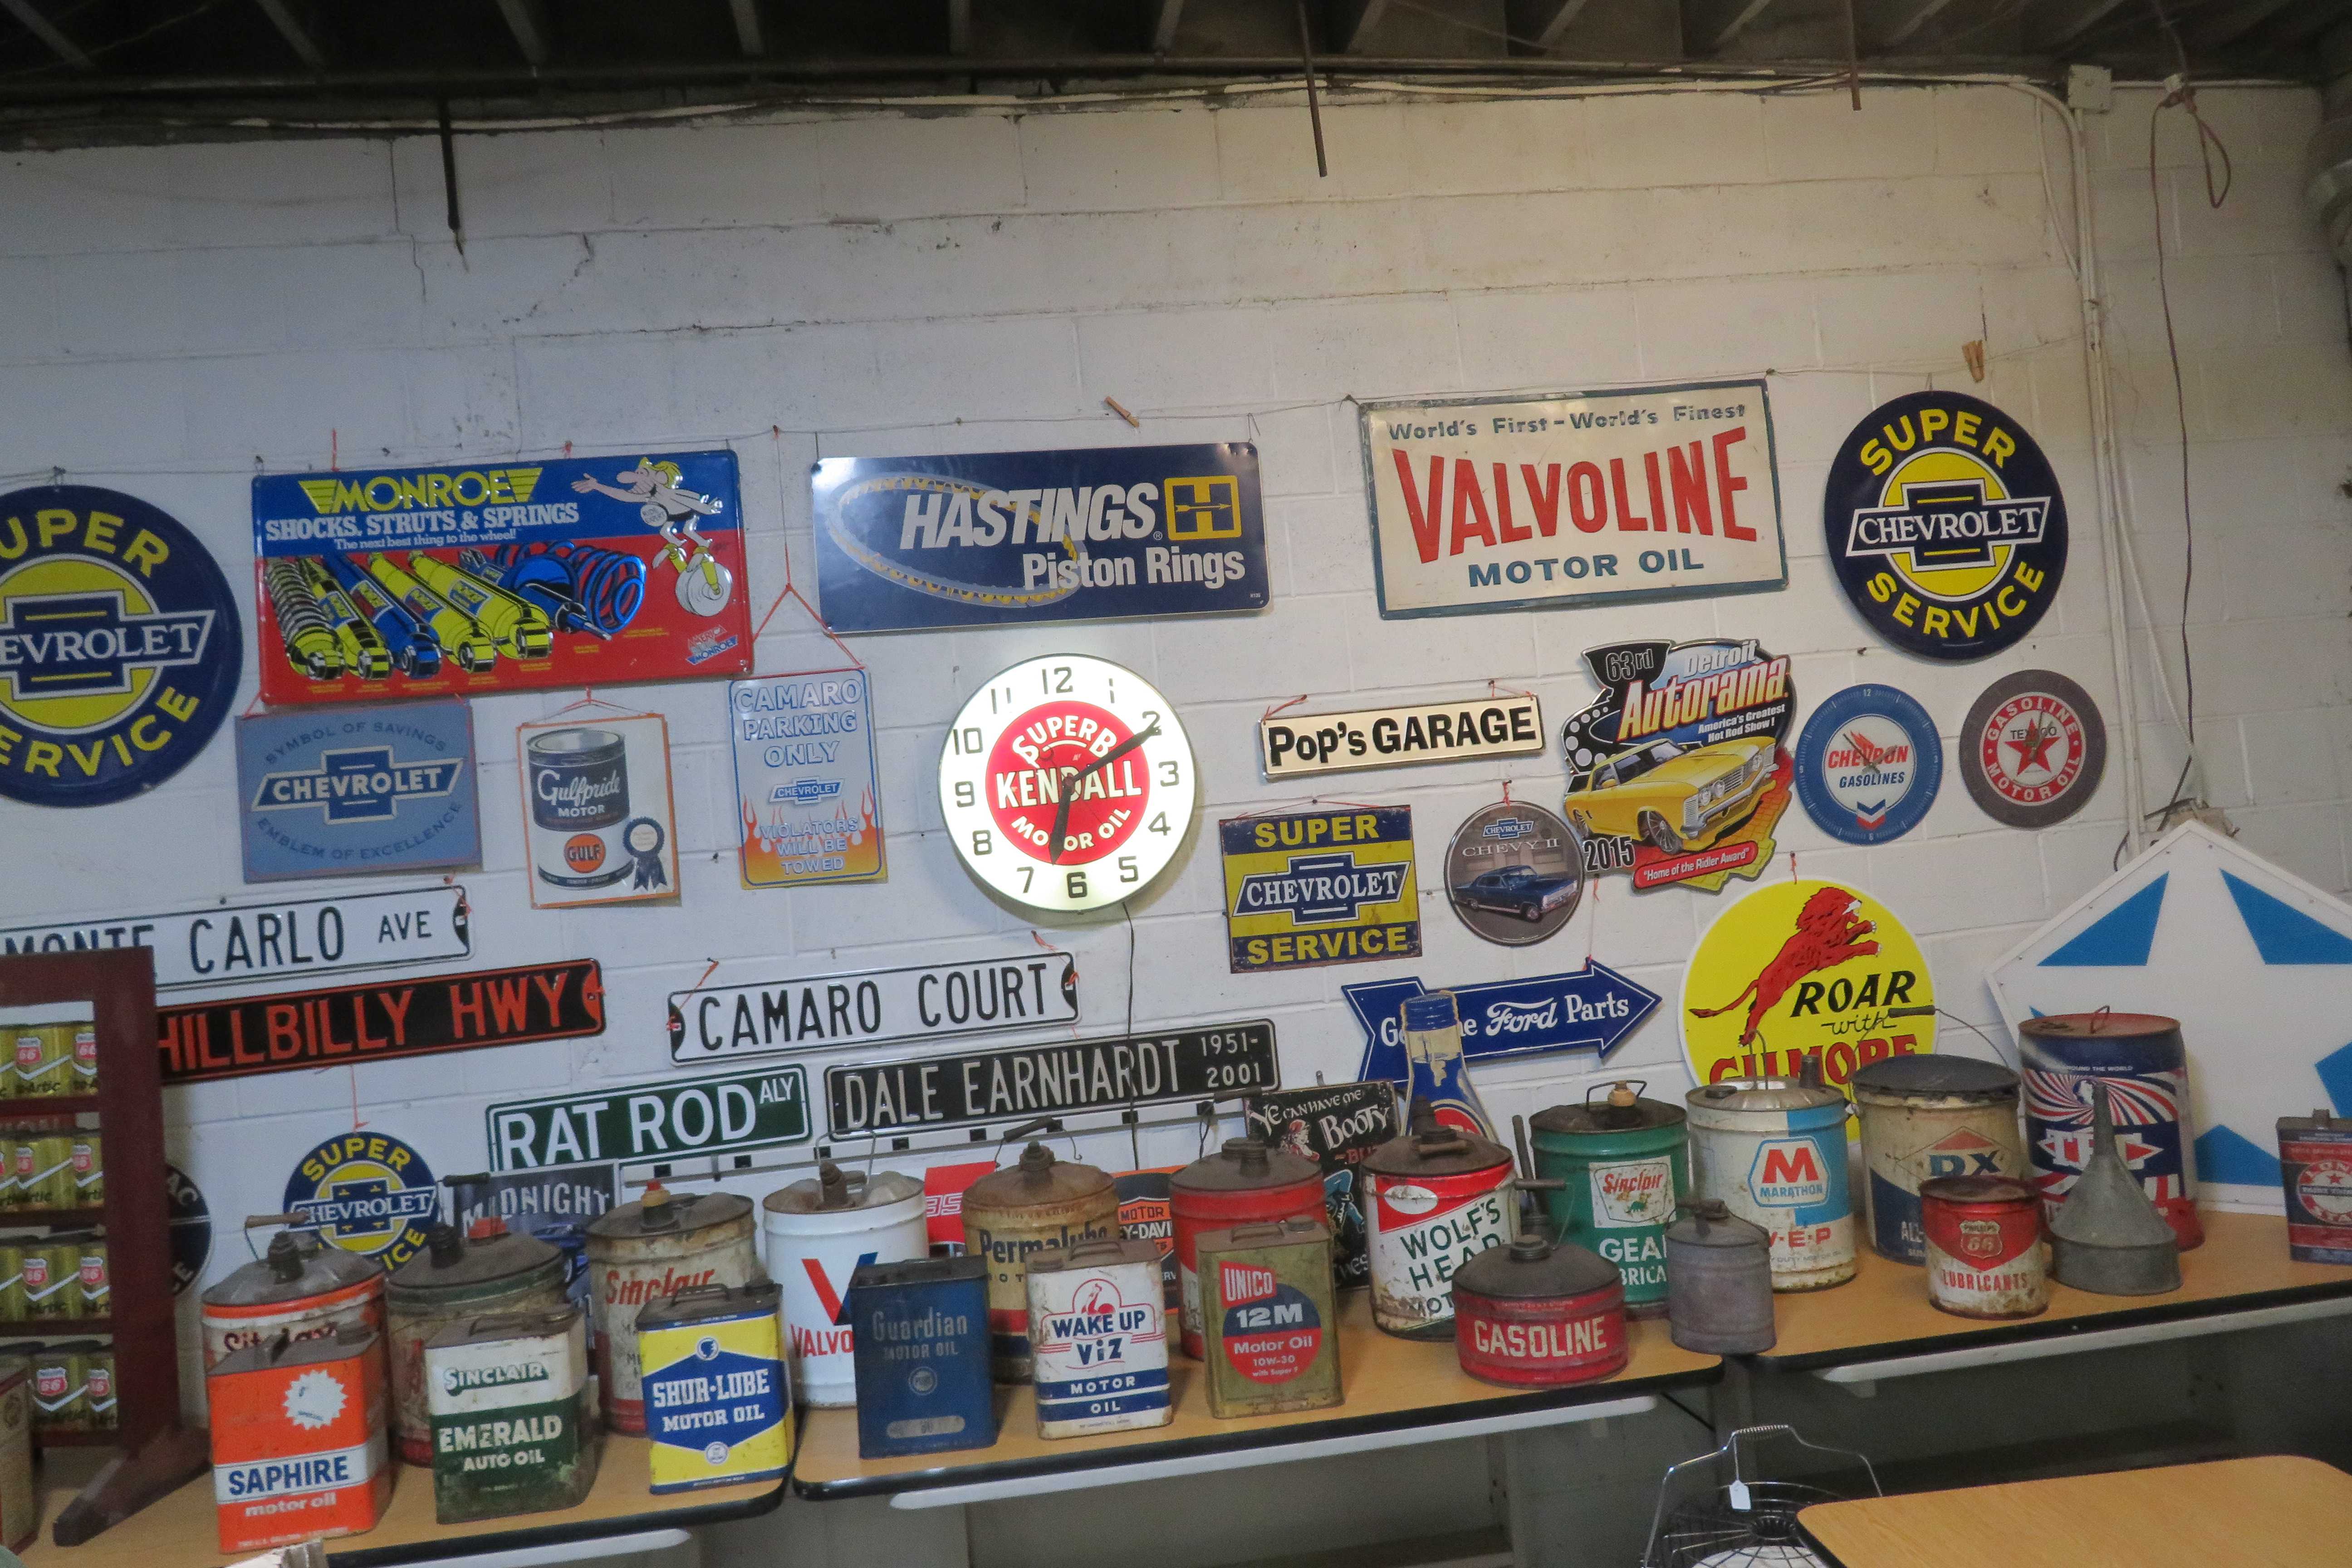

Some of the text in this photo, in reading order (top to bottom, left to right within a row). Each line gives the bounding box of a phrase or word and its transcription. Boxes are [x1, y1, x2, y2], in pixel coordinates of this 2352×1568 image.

[1390, 404, 1746, 440] World's First World's Finest
[1860, 409, 2017, 475] SUPER
[332, 470, 517, 513] MONROE
[1392, 426, 1757, 564] VALVOLINE
[461, 509, 478, 531] &
[483, 503, 579, 529] SPRINGS
[900, 483, 1158, 549] HASTINGS
[1858, 508, 2041, 544] CHEVROLET
[0, 509, 170, 578] UPER
[334, 538, 357, 550] The
[360, 537, 385, 549] next
[387, 536, 411, 547] best
[414, 534, 444, 547] thing
[446, 533, 457, 543] to
[460, 532, 477, 542] the
[1023, 546, 1245, 590] Piston Rings
[1468, 549, 1704, 587] MOTOR OIL
[1867, 561, 2045, 638] SERVICE
[0, 622, 199, 665] EVROLET
[695, 637, 736, 662] MONROE
[1606, 649, 1654, 681] 63rd
[1683, 640, 1757, 679] Detroit
[1042, 666, 1073, 694] 12
[734, 679, 862, 713] CAMARO
[991, 687, 1011, 714] 11
[1616, 657, 1788, 742] Autorama
[0, 686, 200, 777] ERVICE
[744, 710, 858, 740] PARKING
[1142, 710, 1162, 735] 2
[1698, 704, 1785, 734] America's Greatest
[1987, 697, 2078, 740] GASOLINE
[265, 722, 446, 764] SYMBOL OF SAVINGS
[953, 727, 983, 755] 10
[1012, 715, 1117, 768] SUPERB
[1268, 706, 1536, 766] Pop's GARAGE
[1708, 731, 1724, 743] Hot
[1725, 725, 1743, 738] Rod
[764, 740, 840, 767] ONLY
[1828, 746, 1909, 769] CHEVRON
[272, 768, 442, 801] CHEVROLET
[537, 769, 620, 806] Gulfpride
[996, 760, 1142, 809] KENDALL
[1159, 760, 1179, 787] 3
[1839, 772, 1906, 788] GASOLINES
[1988, 757, 2080, 801] MOTOR OIL
[777, 782, 838, 797] CHEVROLET
[955, 781, 975, 808] 9
[558, 805, 605, 817] MOTOR
[1148, 812, 1171, 836] 4
[258, 803, 462, 860] EMBLEM OF EXCELLENCE
[761, 817, 860, 839] VIOLATORS
[973, 830, 992, 855] 8
[1011, 808, 1131, 851] MOOR OIL
[1255, 814, 1379, 848] SUPER
[1485, 823, 1532, 835] CHEVROLET
[568, 844, 601, 862] GULF
[776, 838, 847, 857] WILL BE
[1462, 838, 1560, 857] CHEVY II
[1584, 836, 1636, 871] 2015
[782, 857, 844, 875] TOWED
[1017, 867, 1034, 893] 7
[1118, 856, 1138, 882] 5
[1671, 864, 1680, 874] of
[1681, 862, 1694, 873] the
[1696, 856, 1719, 869] Ridler
[1067, 872, 1087, 898] 6
[1247, 871, 1397, 906] CHEVROLET
[189, 906, 345, 974] CARLO
[377, 910, 431, 943] AVE
[1247, 926, 1408, 965] SERVICE
[698, 963, 1047, 1051] CAMARO COURT
[1790, 970, 1916, 1018] ROAR
[157, 972, 569, 1072] HILLBILLY HWY
[1485, 997, 1558, 1036] Ford
[1564, 992, 1629, 1024] Parts
[1821, 1012, 1897, 1034] with
[844, 1039, 1181, 1130] DALE EARNHARDT
[1206, 1062, 1262, 1088] 2001
[498, 1076, 794, 1171] RAT ROD ALY
[303, 1137, 411, 1181] SUPER
[1762, 1147, 1818, 1183] M
[1929, 1150, 2000, 1177] DX
[1603, 1171, 1663, 1193] Sinclair
[1760, 1185, 1823, 1198] MARATHON
[461, 1182, 610, 1238] MIDNIGHT
[1121, 1207, 1164, 1220] MOTOR
[1400, 1197, 1501, 1260] WOLF'S
[1599, 1235, 1667, 1263] GEA
[1225, 1268, 1273, 1301] UNICO
[1942, 1269, 2028, 1292] LUBRICANTS
[872, 1306, 967, 1341] Guardian
[1052, 1310, 1146, 1338] WAKE UP
[1236, 1303, 1303, 1328] 12M
[791, 1323, 854, 1360] VALVO
[936, 1341, 958, 1357] OIL
[1234, 1335, 1313, 1354] Motor Oil
[1474, 1316, 1607, 1358] GASOLINE
[1252, 1368, 1269, 1377] with
[1253, 1355, 1295, 1366] 10W-30
[1071, 1377, 1135, 1395] MOTOR
[662, 1404, 765, 1433] MOTOR OIL
[1090, 1401, 1121, 1414] OIL
[438, 1415, 562, 1452] EMERALD
[229, 1455, 349, 1496] SAPHIRE
[463, 1449, 545, 1472] AUTO OIL
[245, 1492, 336, 1517] motor oil
